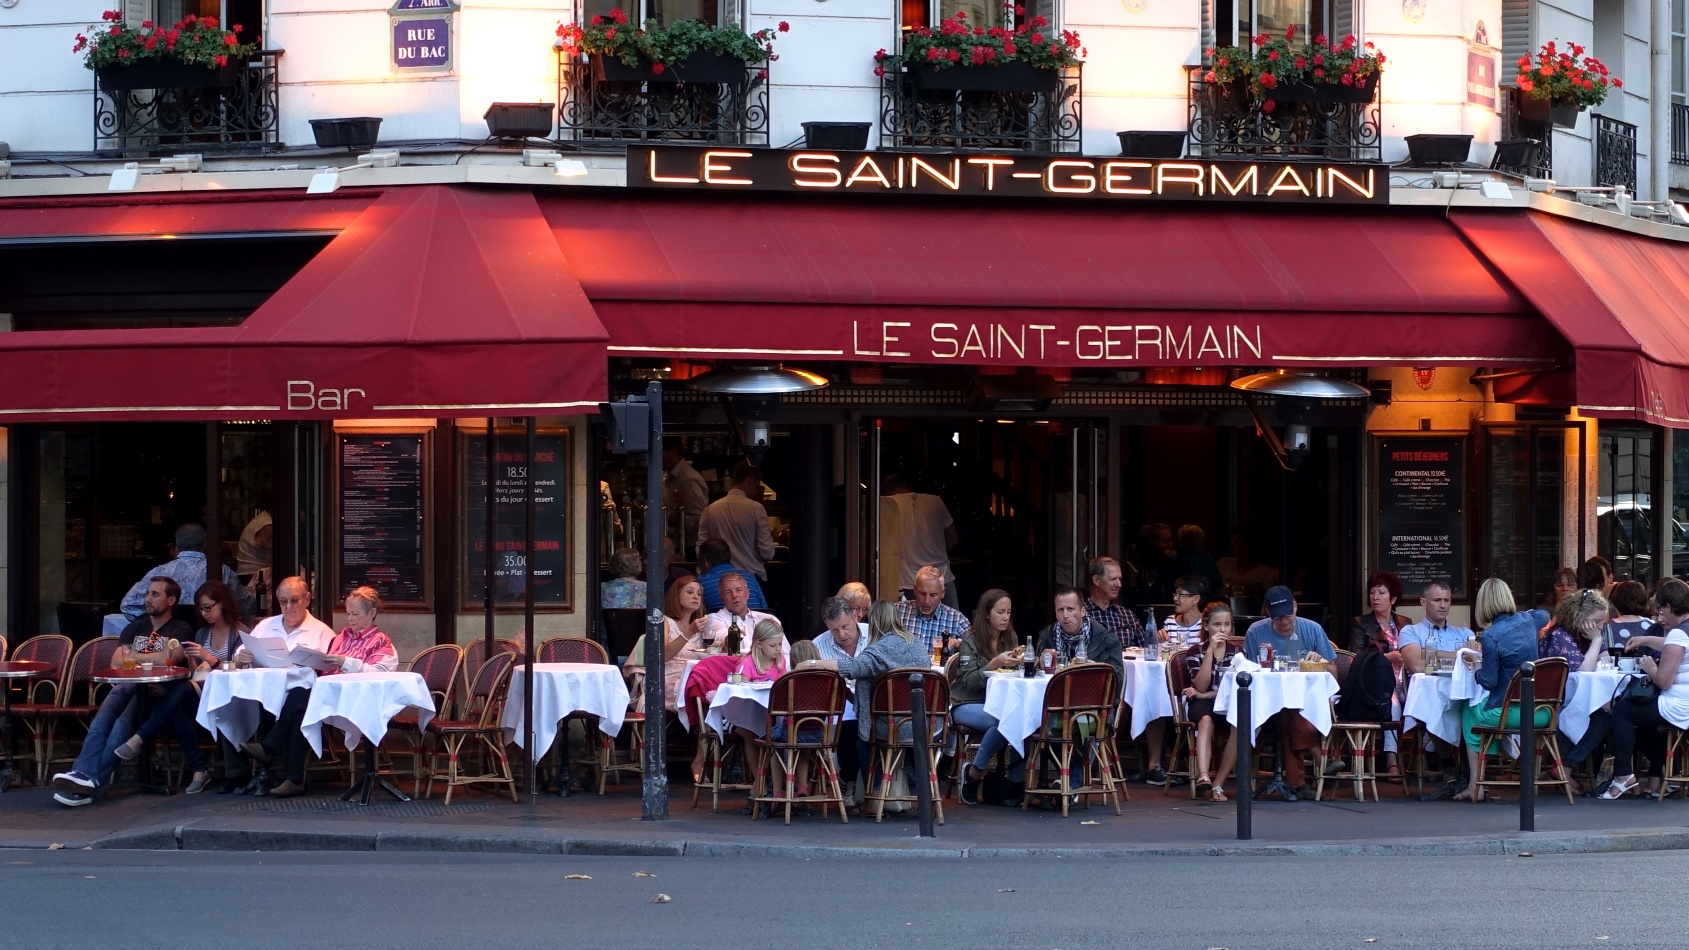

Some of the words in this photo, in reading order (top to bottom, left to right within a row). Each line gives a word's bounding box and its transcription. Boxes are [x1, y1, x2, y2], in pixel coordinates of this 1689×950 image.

[407, 29, 436, 41] RUE
[398, 47, 416, 59] DU
[420, 46, 446, 58] BAC
[650, 150, 754, 185] LE
[791, 153, 1375, 200] SAINT-GERMAIN
[853, 320, 911, 357] LE
[930, 323, 1262, 360] SAINT-GERMAIN
[287, 380, 366, 411] Bar
[1392, 451, 1413, 461] PETITS
[1414, 450, 1449, 461] DÉJEUNERS
[510, 496, 523, 505] jour
